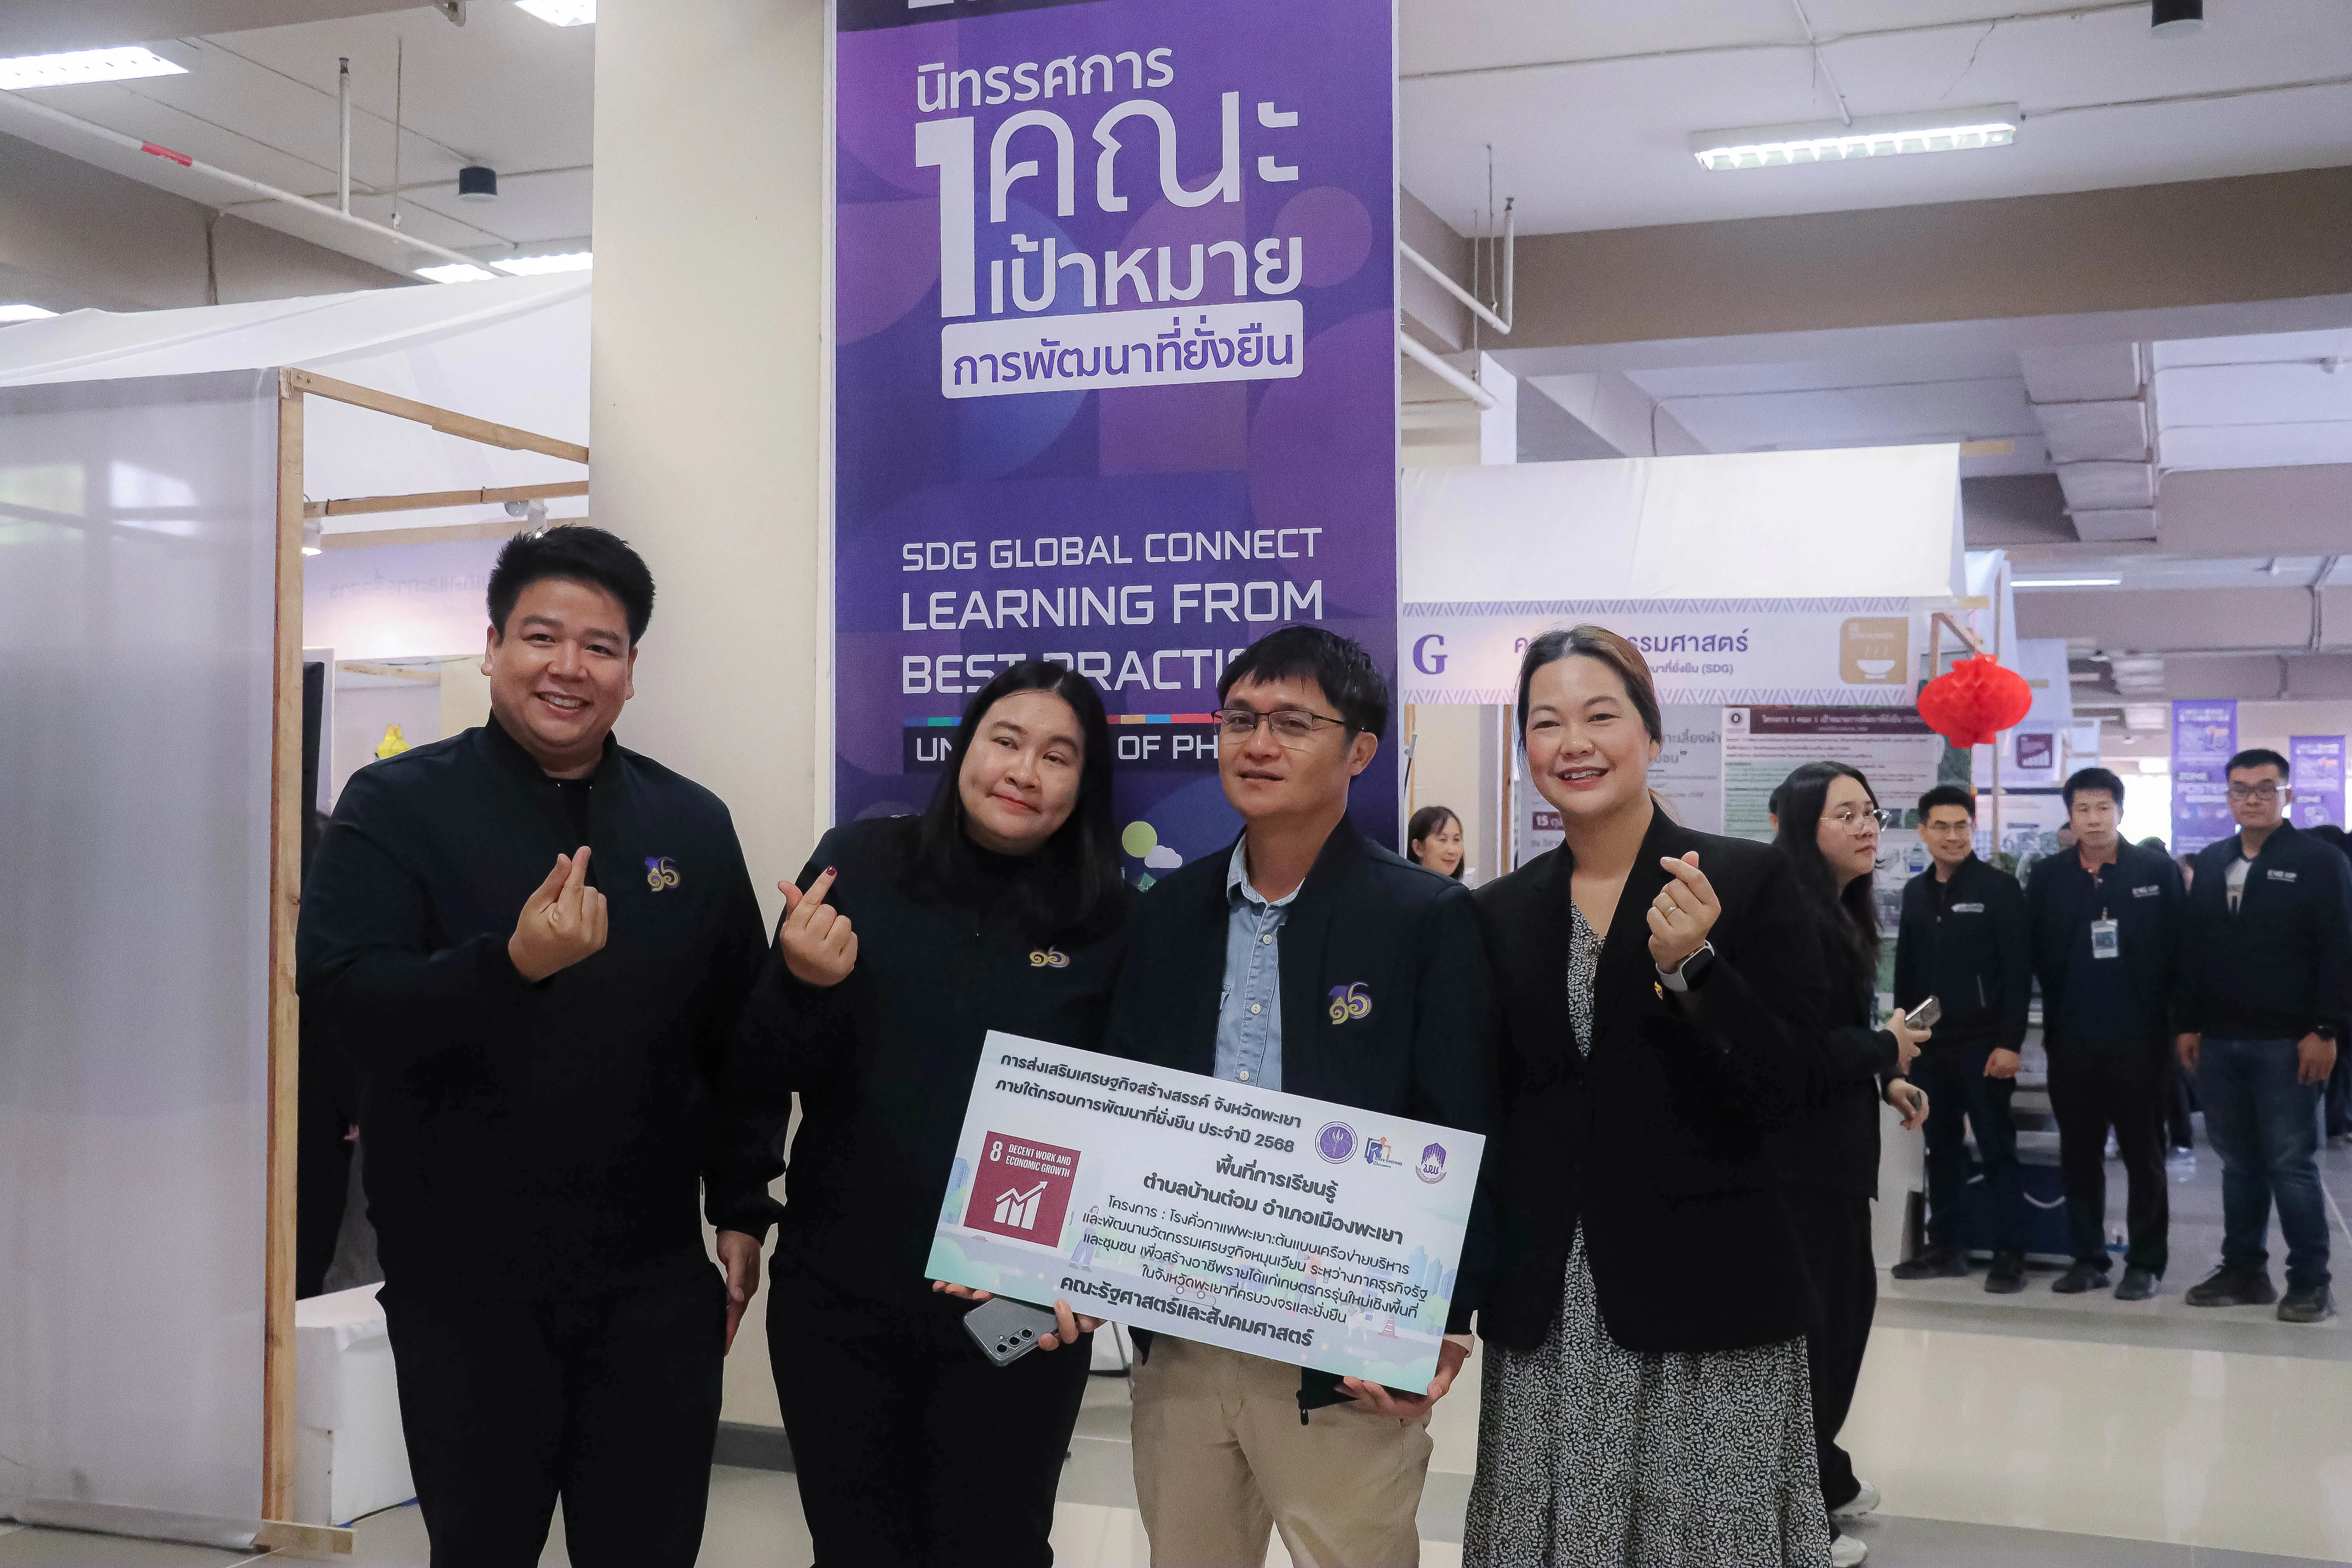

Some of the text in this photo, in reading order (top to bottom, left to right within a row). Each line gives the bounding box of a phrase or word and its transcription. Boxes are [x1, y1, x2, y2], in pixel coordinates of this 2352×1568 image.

[916, 47, 1174, 113] นิทรรศการ
[990, 91, 1299, 223] คณะ
[991, 233, 1302, 315] เป้าหมาย
[954, 315, 1294, 386] การพัฒนาที่ยั่งยืน
[903, 527, 1322, 571] SDG GLOBAL CONNECT
[903, 580, 1323, 631] LEARNING FROM
[1044, 648, 1247, 691] RACTI
[1412, 633, 1448, 675] G
[1118, 735, 1160, 760] OF
[1000, 1054, 1301, 1128] การส่งเสริมเศรษฐกิจสร้างสรรค์ จังหวัดพะเยา
[995, 1080, 1195, 1132] ภายใต้กรอบการพัฒนาที่ยั่งยืน
[1198, 1122, 1251, 1143] ประจำปี
[1254, 1133, 1294, 1152] 2568
[989, 1140, 1003, 1161] 8
[1005, 1155, 1071, 1178] ECONOMIC GROWTH
[1008, 1143, 1071, 1166] DECENT WORK AND
[1216, 1153, 1339, 1203] พื้นที่การเรียนรู้
[1108, 1194, 1158, 1218] โครงการ
[1262, 1198, 1403, 1245] อำเภอเมืองพะเยา
[1083, 1233, 1136, 1255] และชุมชน
[1310, 1265, 1428, 1302] ระหว่างภาคธุรกิจรัฐ
[1060, 1276, 1315, 1346] คณะรัฐศาสตร์และสังคมศาสตร์
